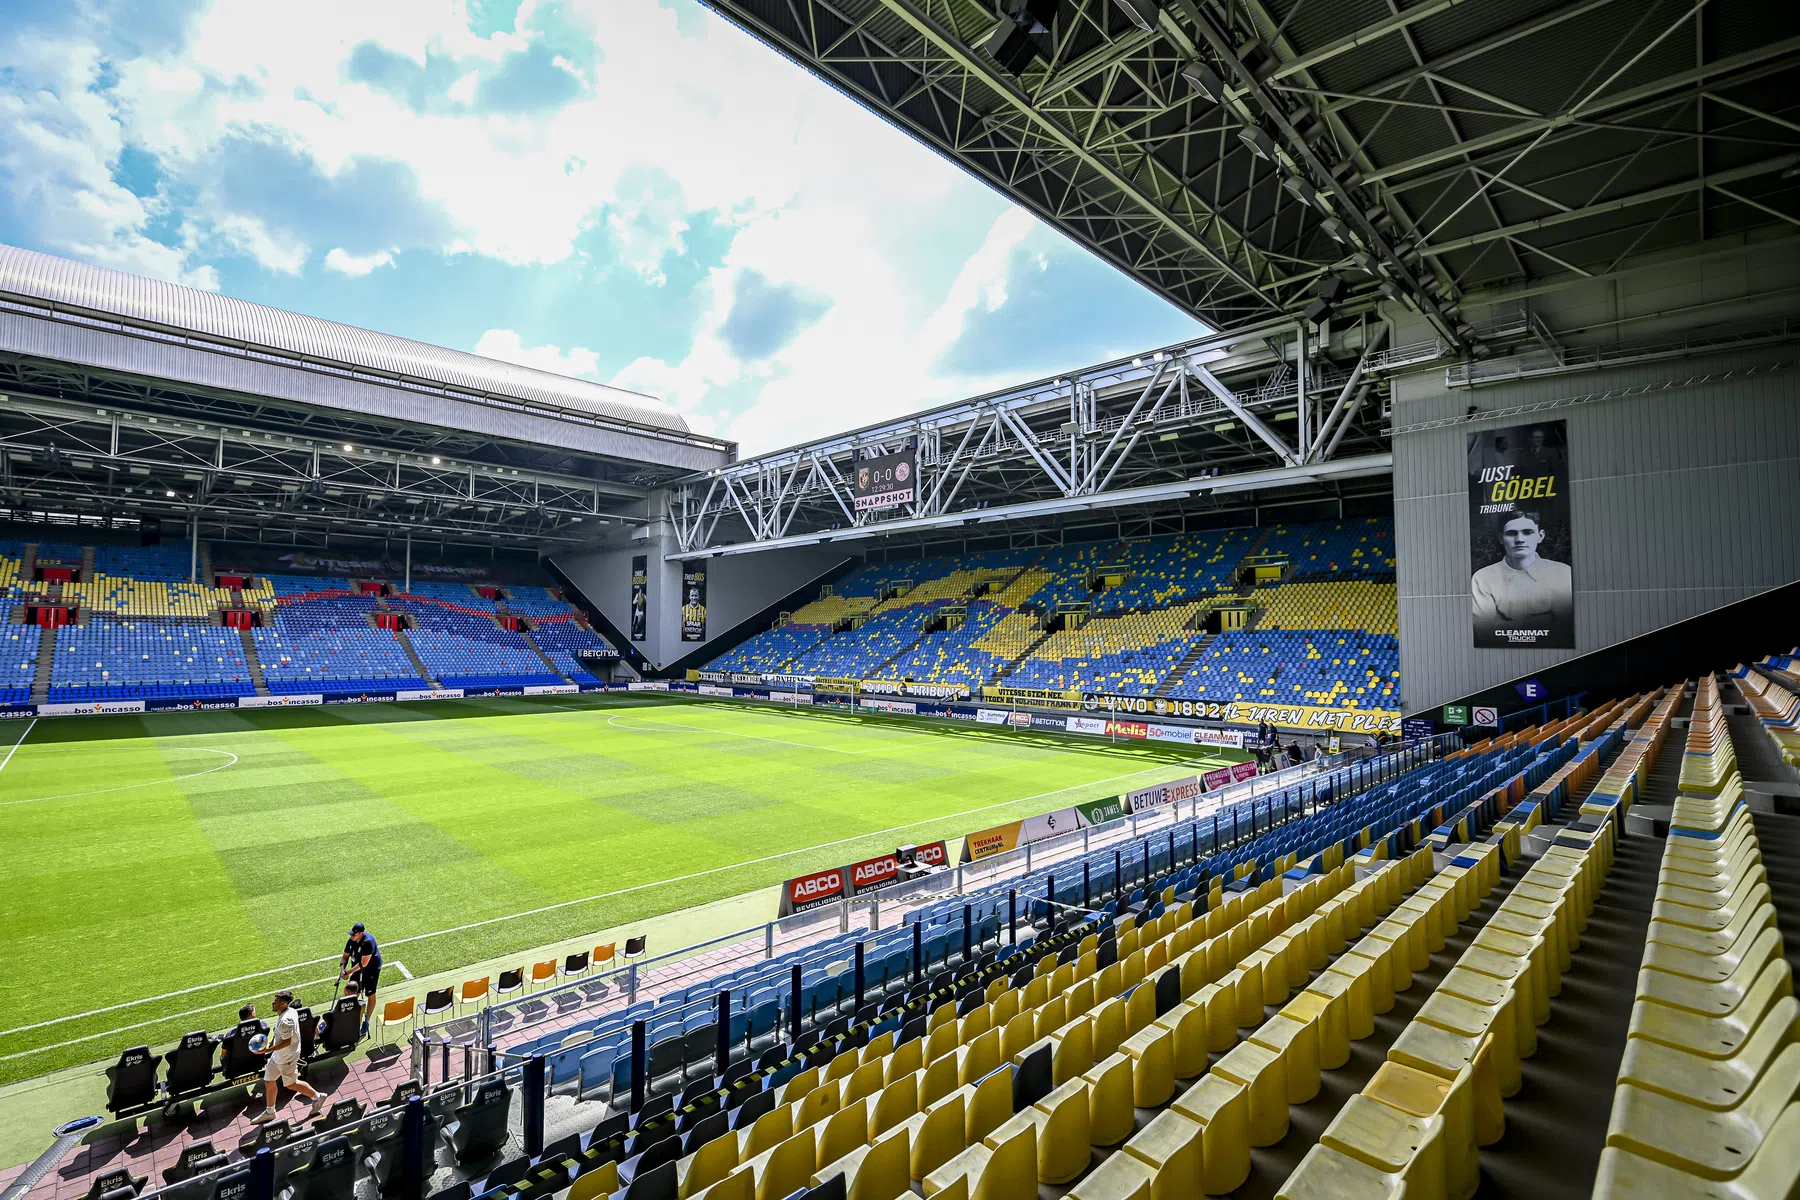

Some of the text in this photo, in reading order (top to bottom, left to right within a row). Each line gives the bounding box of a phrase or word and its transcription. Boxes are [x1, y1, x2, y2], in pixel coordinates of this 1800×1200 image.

[1478, 464, 1514, 484] JUST
[1491, 475, 1557, 502] GÖBEL
[856, 491, 911, 507] SNAPPSHOT
[1479, 502, 1514, 514] TRIBUNE
[694, 572, 705, 581] BOS
[1494, 629, 1550, 637] CLEANMAT
[866, 683, 893, 694] ZUID
[998, 688, 1026, 697] VITESSE
[1027, 690, 1046, 698] STEM
[1526, 684, 1537, 697] E
[985, 695, 1006, 703] TEGEN
[1046, 699, 1071, 708] FRANK
[1104, 696, 1220, 718] VIVO 1892
[935, 710, 947, 718] bos
[1222, 703, 1240, 721] AL
[1248, 706, 1304, 725] JAREN
[1307, 710, 1352, 729] MET
[1105, 723, 1147, 737] Melis
[1194, 732, 1239, 742] CLEANMAT
[1103, 804, 1119, 817] JAMES
[973, 834, 1002, 848] TREKHAAK
[915, 846, 942, 862] BCO
[855, 859, 895, 881] ABCO
[794, 873, 840, 898] ABCO
[857, 879, 898, 895] BEVEILIGING
[796, 894, 842, 912] BEVEILIGING
[240, 1024, 256, 1033] Ekris
[187, 1035, 203, 1044] Ekris
[126, 1053, 143, 1063] Ekris
[231, 1073, 260, 1086] VITESSE
[400, 1087, 416, 1097] Ekris
[440, 1091, 456, 1101] Ekris
[484, 1089, 502, 1099] Ekris
[336, 1105, 353, 1116] Ekris
[370, 1115, 388, 1126] Ekris
[265, 1127, 284, 1138] Ekris
[188, 1151, 208, 1162] Ekris
[322, 1149, 345, 1163] Ekris
[101, 1175, 123, 1188] Ekris
[220, 1183, 246, 1199] Ekris
